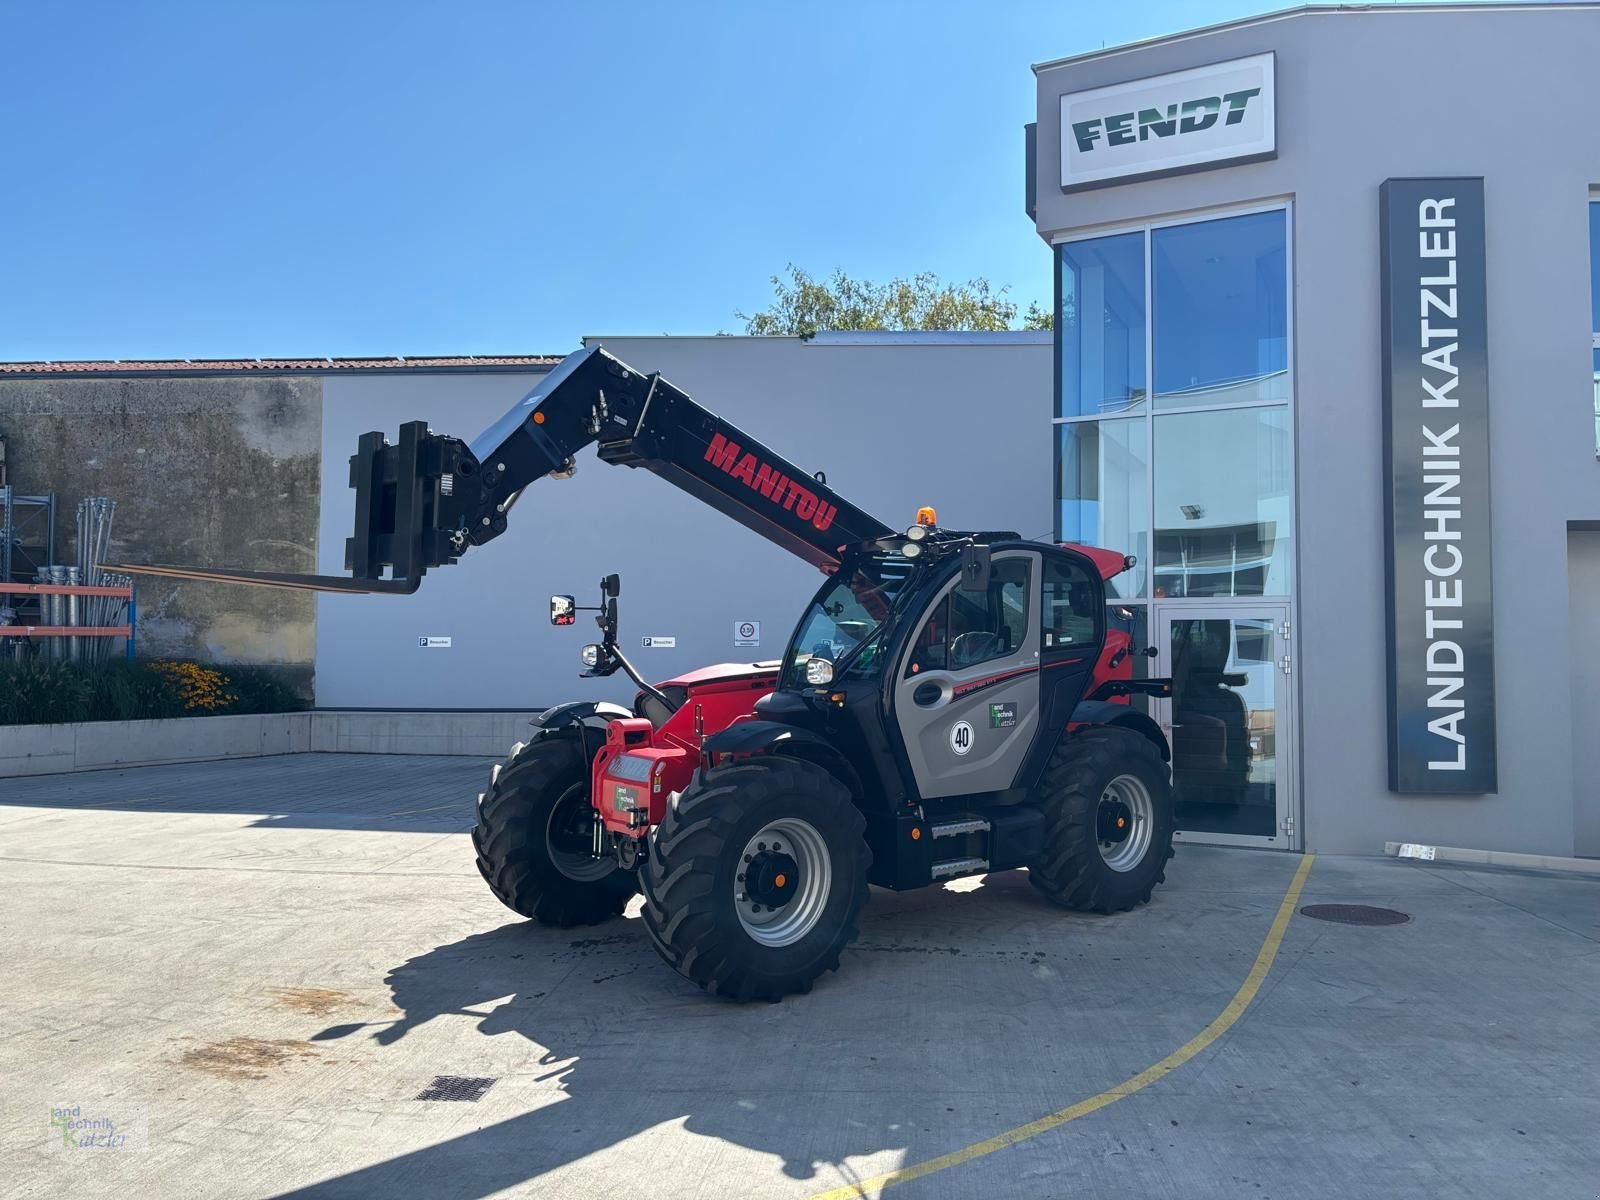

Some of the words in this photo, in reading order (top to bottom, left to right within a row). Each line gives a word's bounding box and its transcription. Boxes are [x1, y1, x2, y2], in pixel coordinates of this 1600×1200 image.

[1072, 87, 1261, 153] FENDT
[1419, 197, 1460, 408] KATZLER
[703, 432, 838, 532] MANITOU
[1422, 422, 1466, 771] LANDTECHNIK
[955, 727, 969, 748] 40
